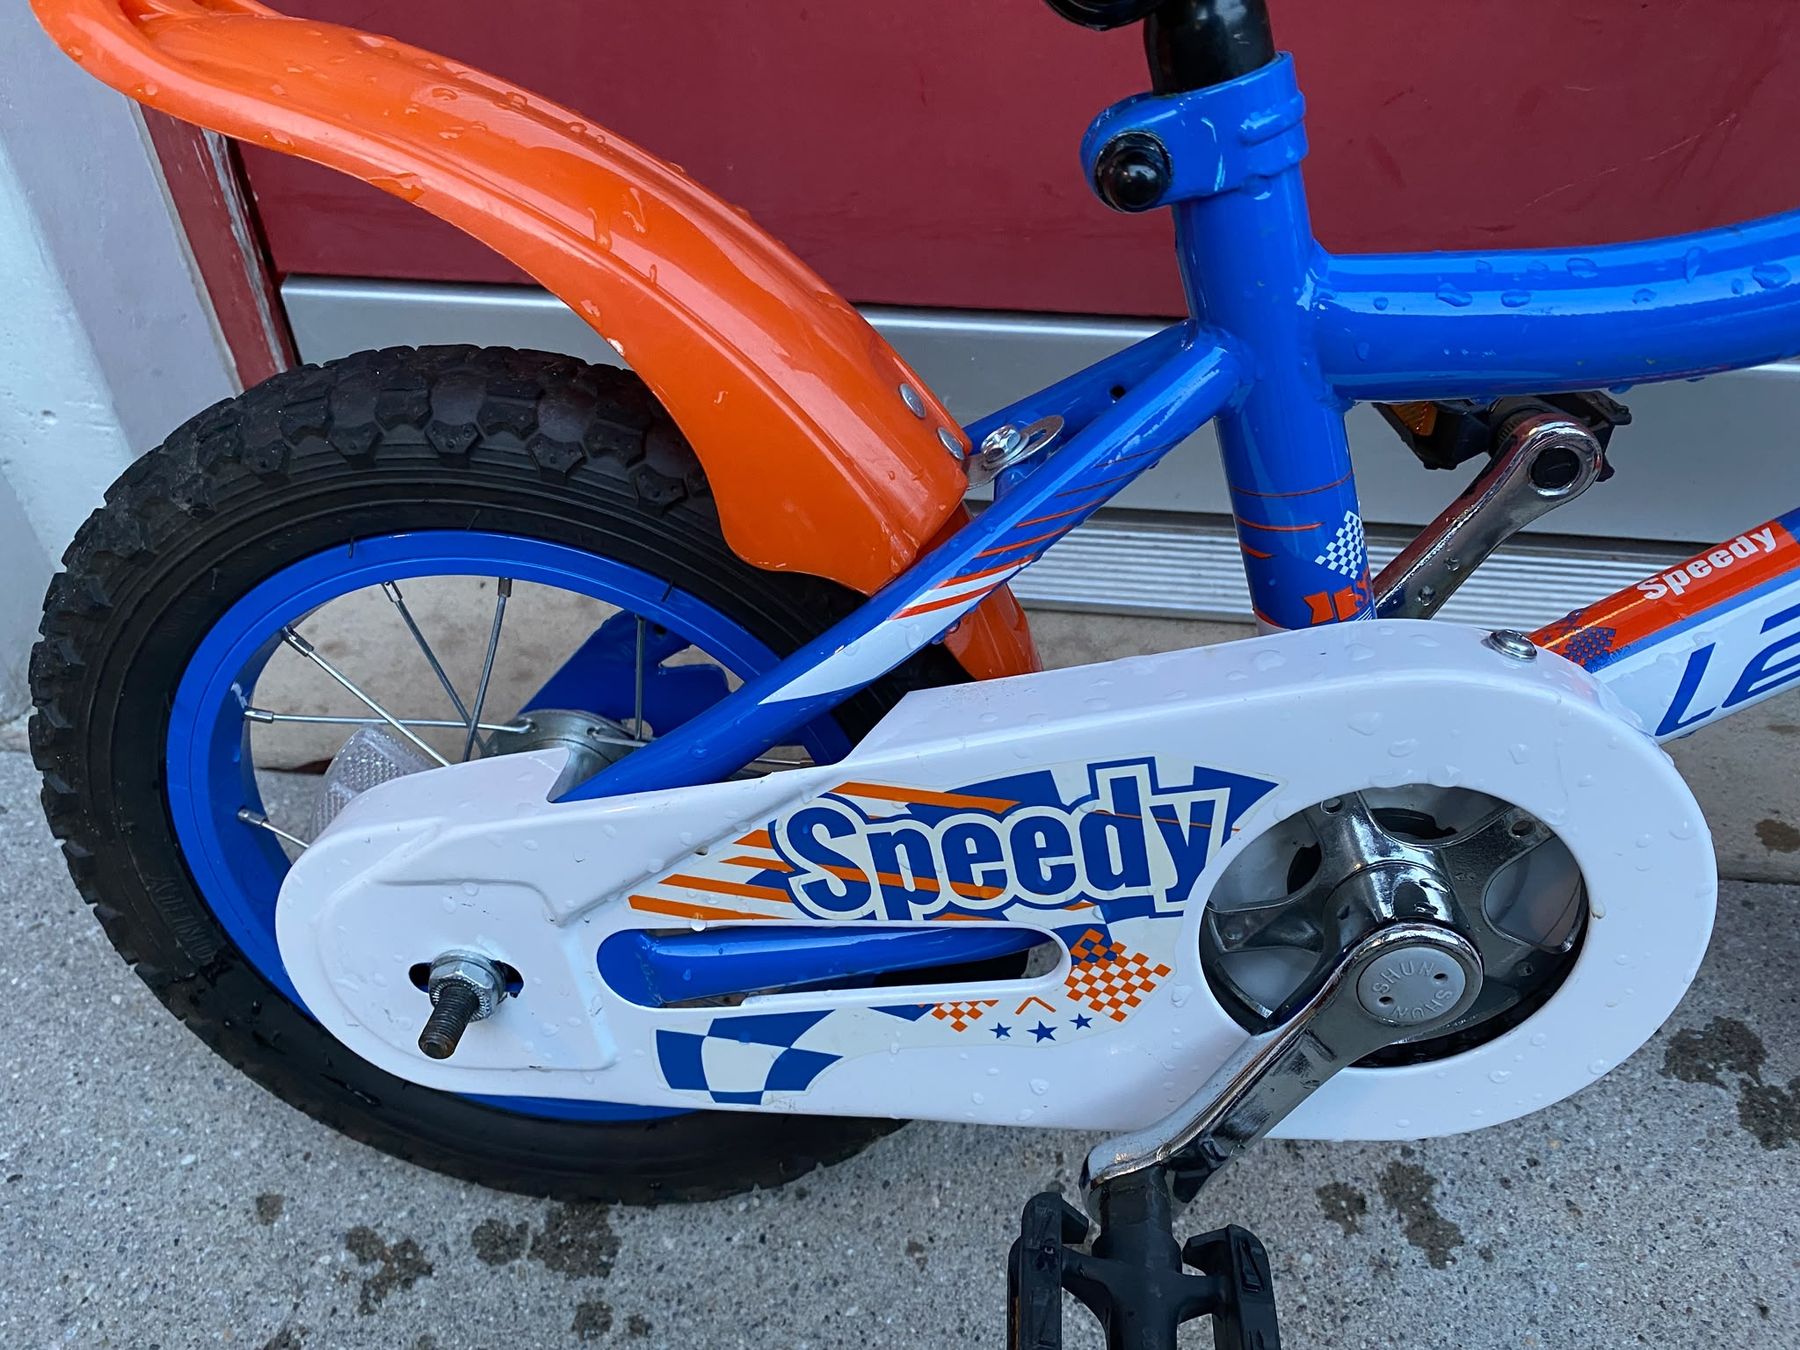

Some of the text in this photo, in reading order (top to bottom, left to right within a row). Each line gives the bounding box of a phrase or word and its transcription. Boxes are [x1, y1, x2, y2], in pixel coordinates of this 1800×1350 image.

[1637, 527, 1776, 600] Speedy
[780, 764, 1229, 920] Speedy
[1372, 960, 1434, 993] SHUN
[1391, 989, 1453, 1018] SHUN
